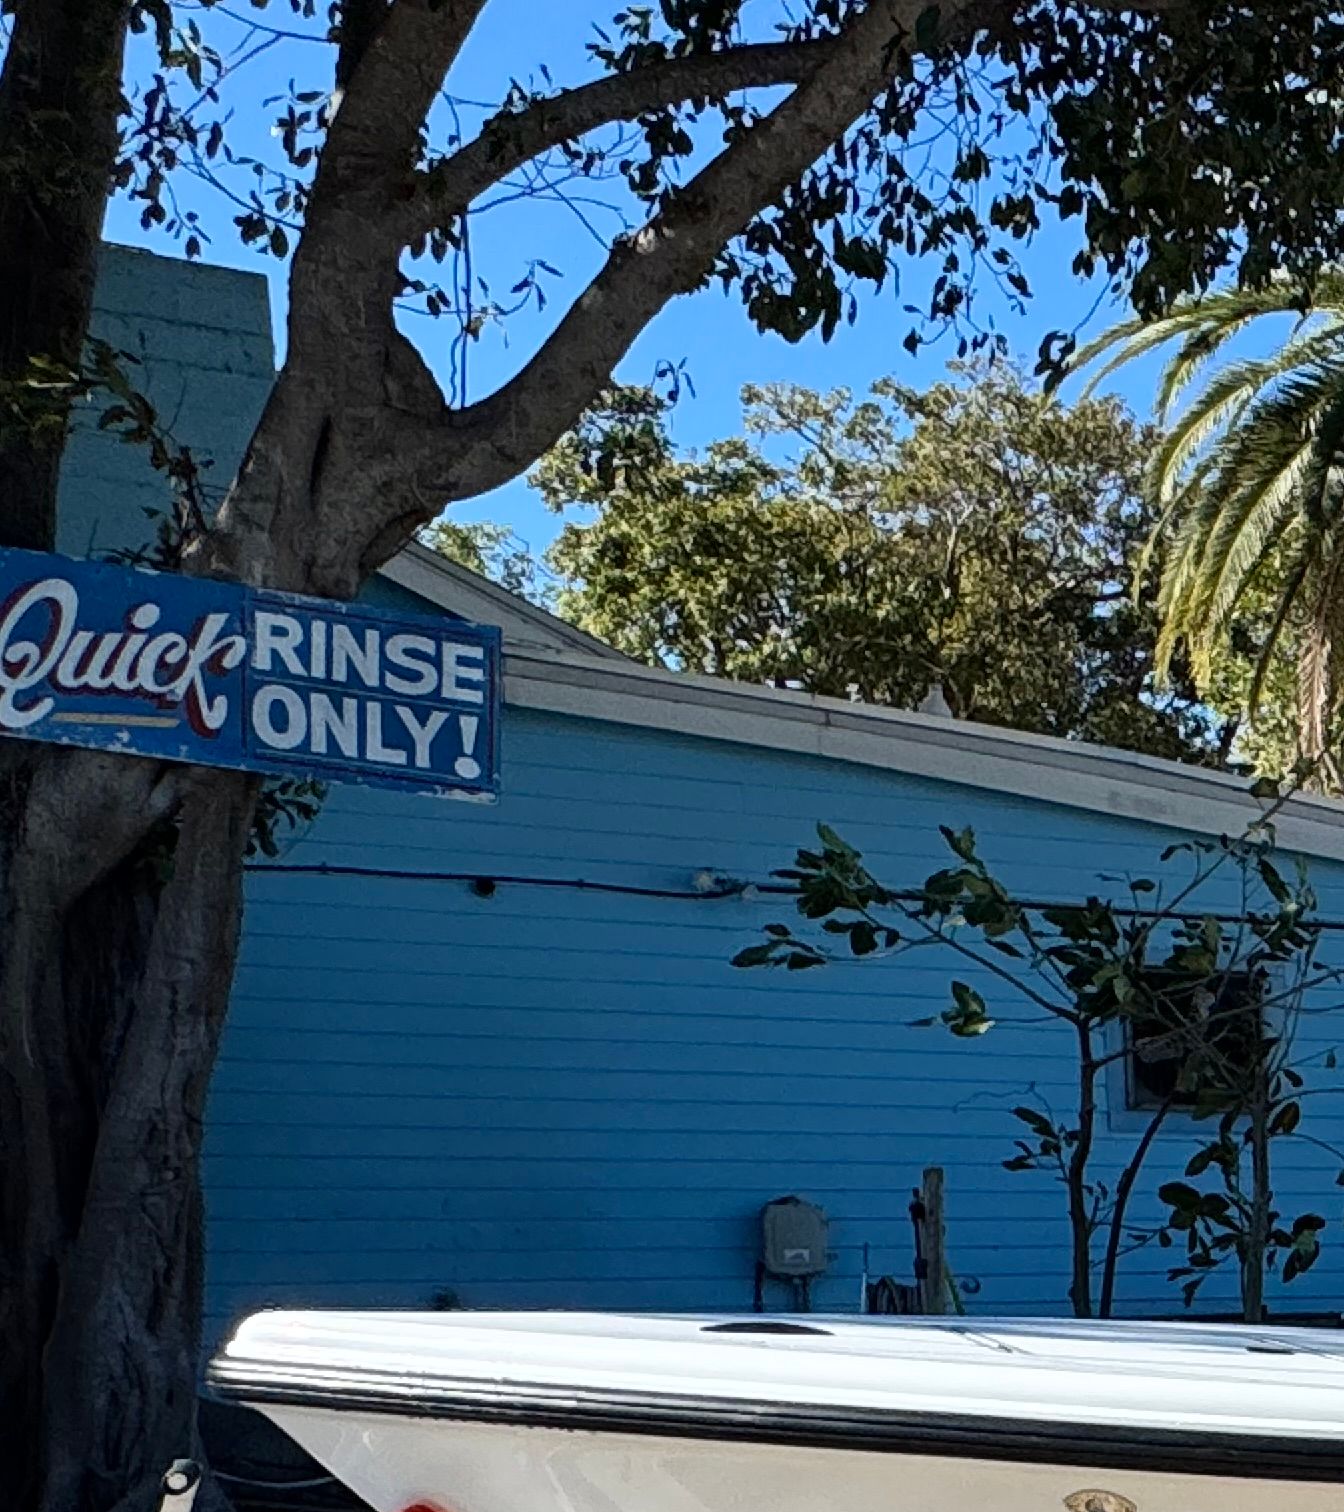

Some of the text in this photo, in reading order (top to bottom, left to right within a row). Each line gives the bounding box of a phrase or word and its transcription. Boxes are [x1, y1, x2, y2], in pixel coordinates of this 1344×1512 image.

[0, 578, 247, 731] Quick
[251, 610, 485, 704] RINSE
[252, 683, 482, 780] ONLY!
